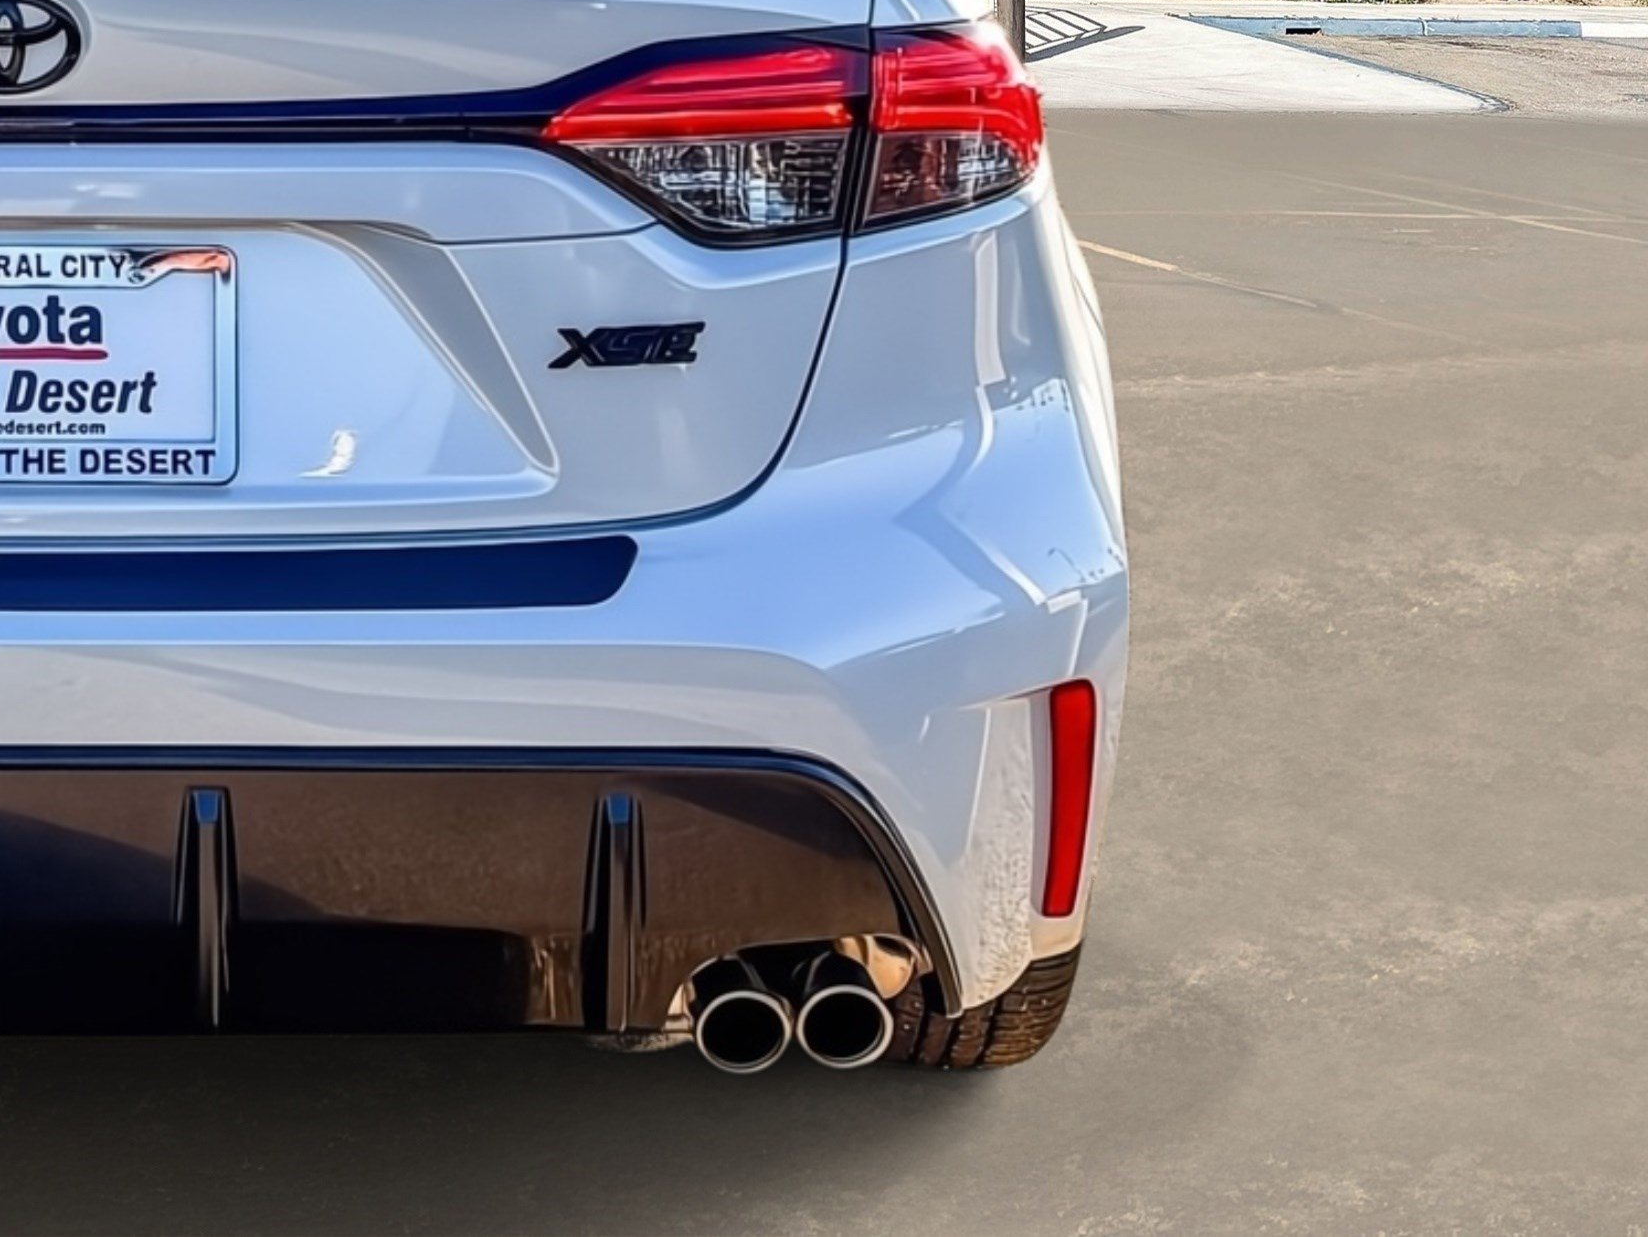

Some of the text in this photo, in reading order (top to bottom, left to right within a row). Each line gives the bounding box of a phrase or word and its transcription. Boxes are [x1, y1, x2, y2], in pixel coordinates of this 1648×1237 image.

[60, 253, 129, 279] CITY
[5, 369, 157, 414] Desert
[79, 448, 216, 476] DESERT
